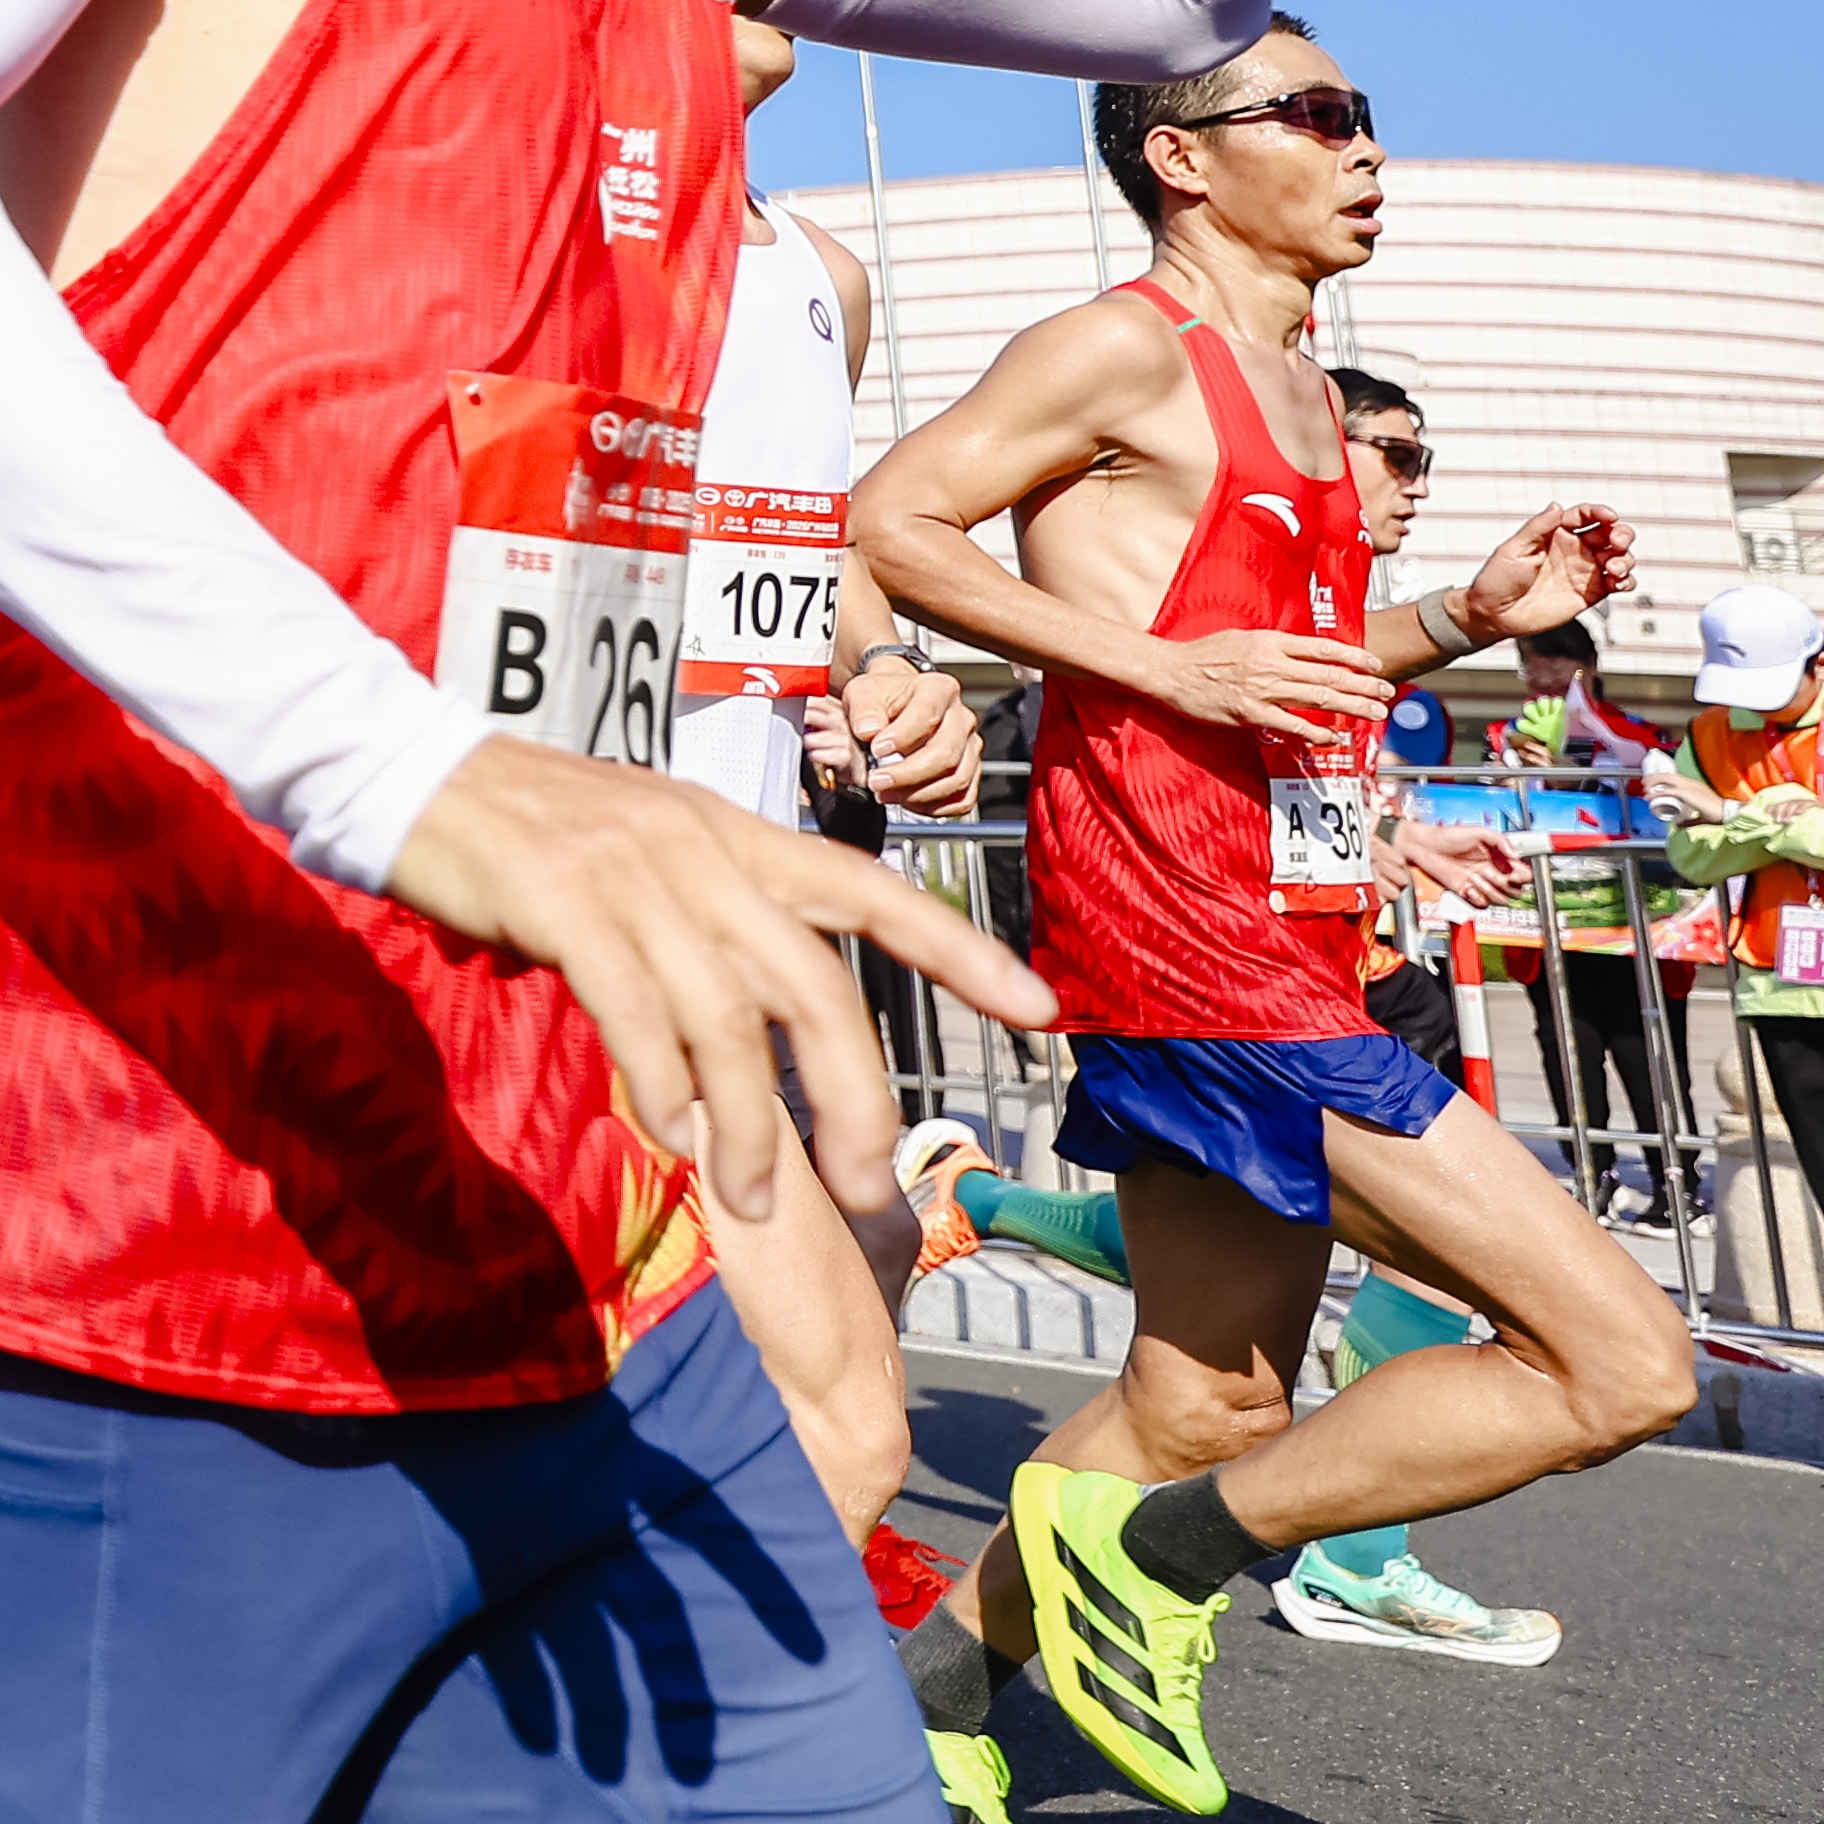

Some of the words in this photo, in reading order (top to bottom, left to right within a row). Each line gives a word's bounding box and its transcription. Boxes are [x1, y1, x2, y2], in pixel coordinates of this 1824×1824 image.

[744, 491, 833, 514] 广汽丰田
[487, 606, 547, 714] B
[587, 615, 679, 771] 26
[1289, 802, 1305, 840] A
